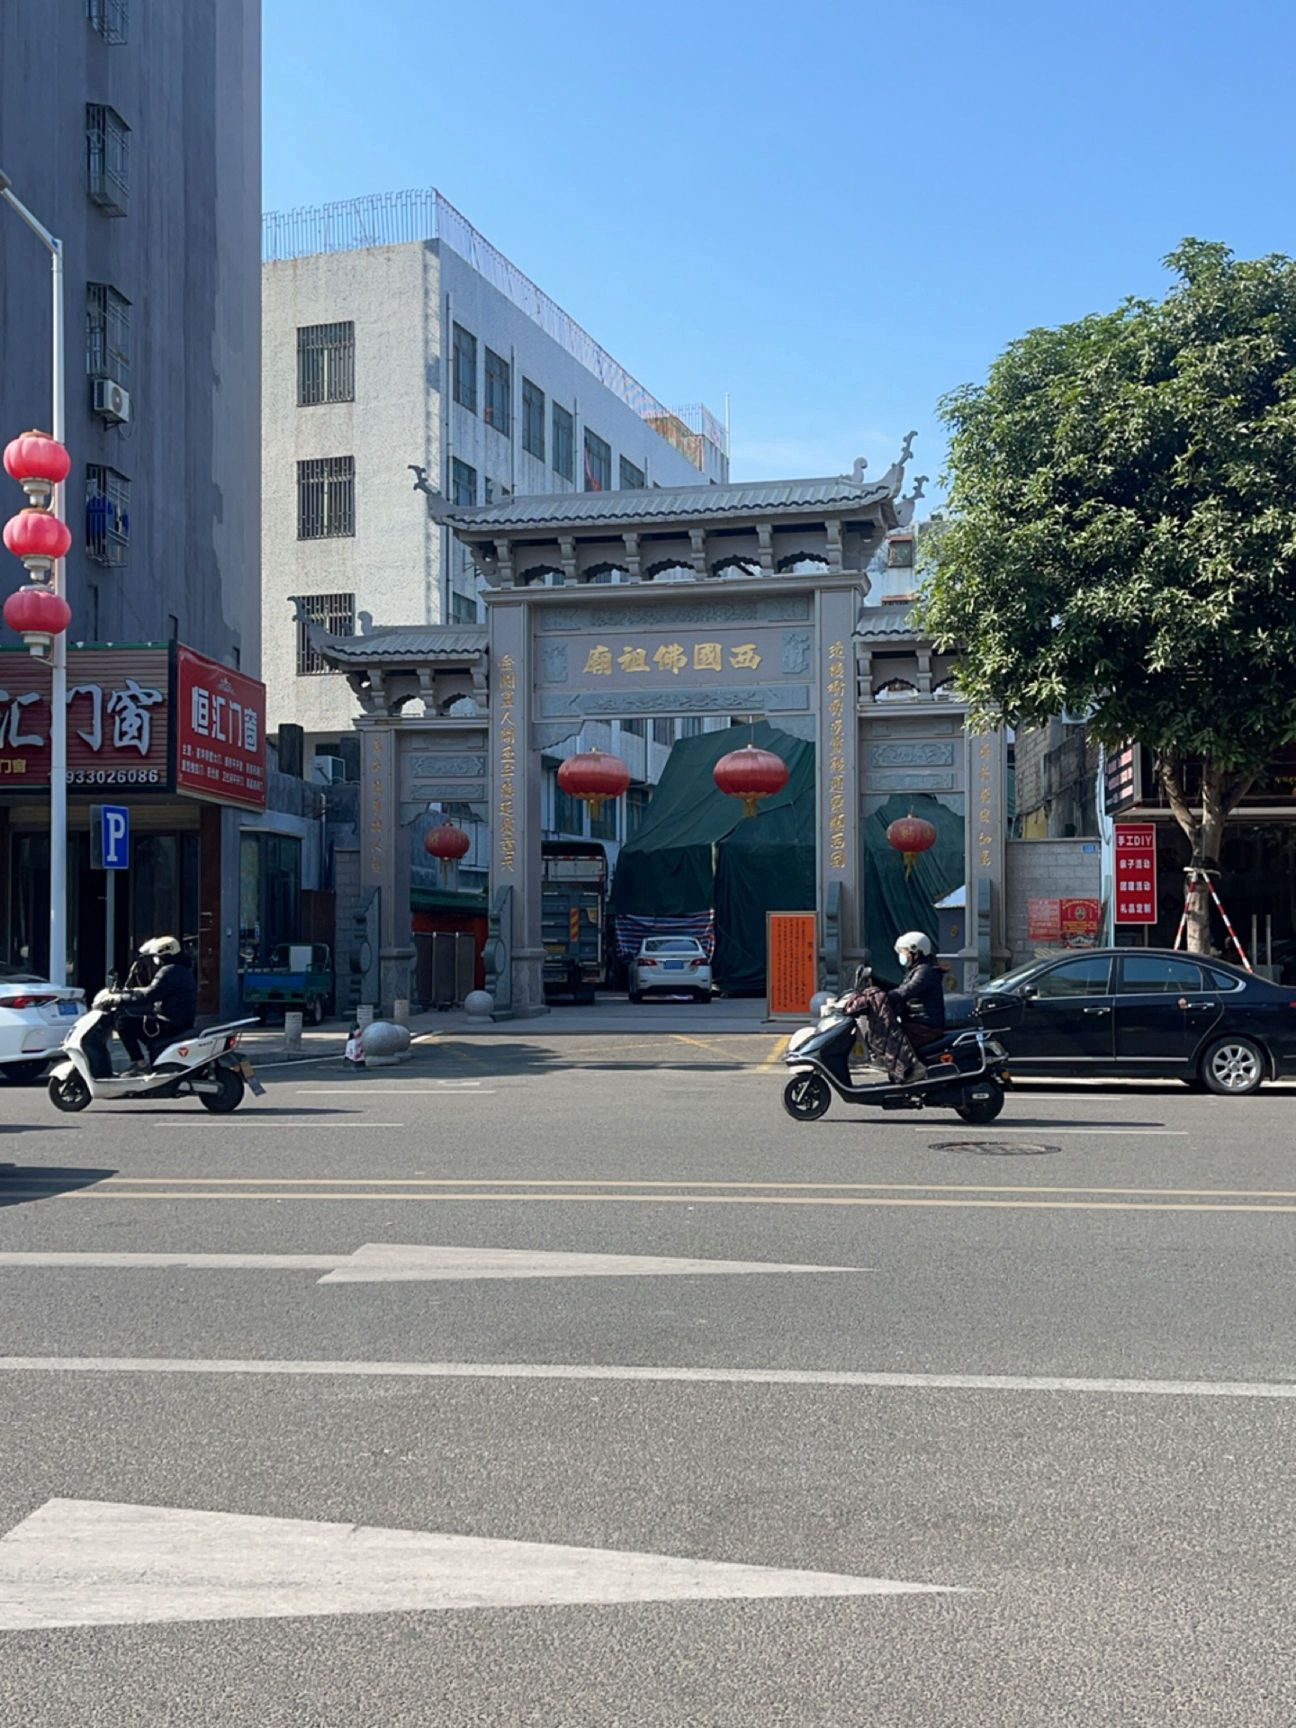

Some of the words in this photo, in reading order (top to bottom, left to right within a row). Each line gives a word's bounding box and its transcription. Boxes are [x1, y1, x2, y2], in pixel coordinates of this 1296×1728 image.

[191, 685, 258, 753] 恒汇门窗
[47, 770, 159, 784] 933026086
[106, 812, 126, 862] P
